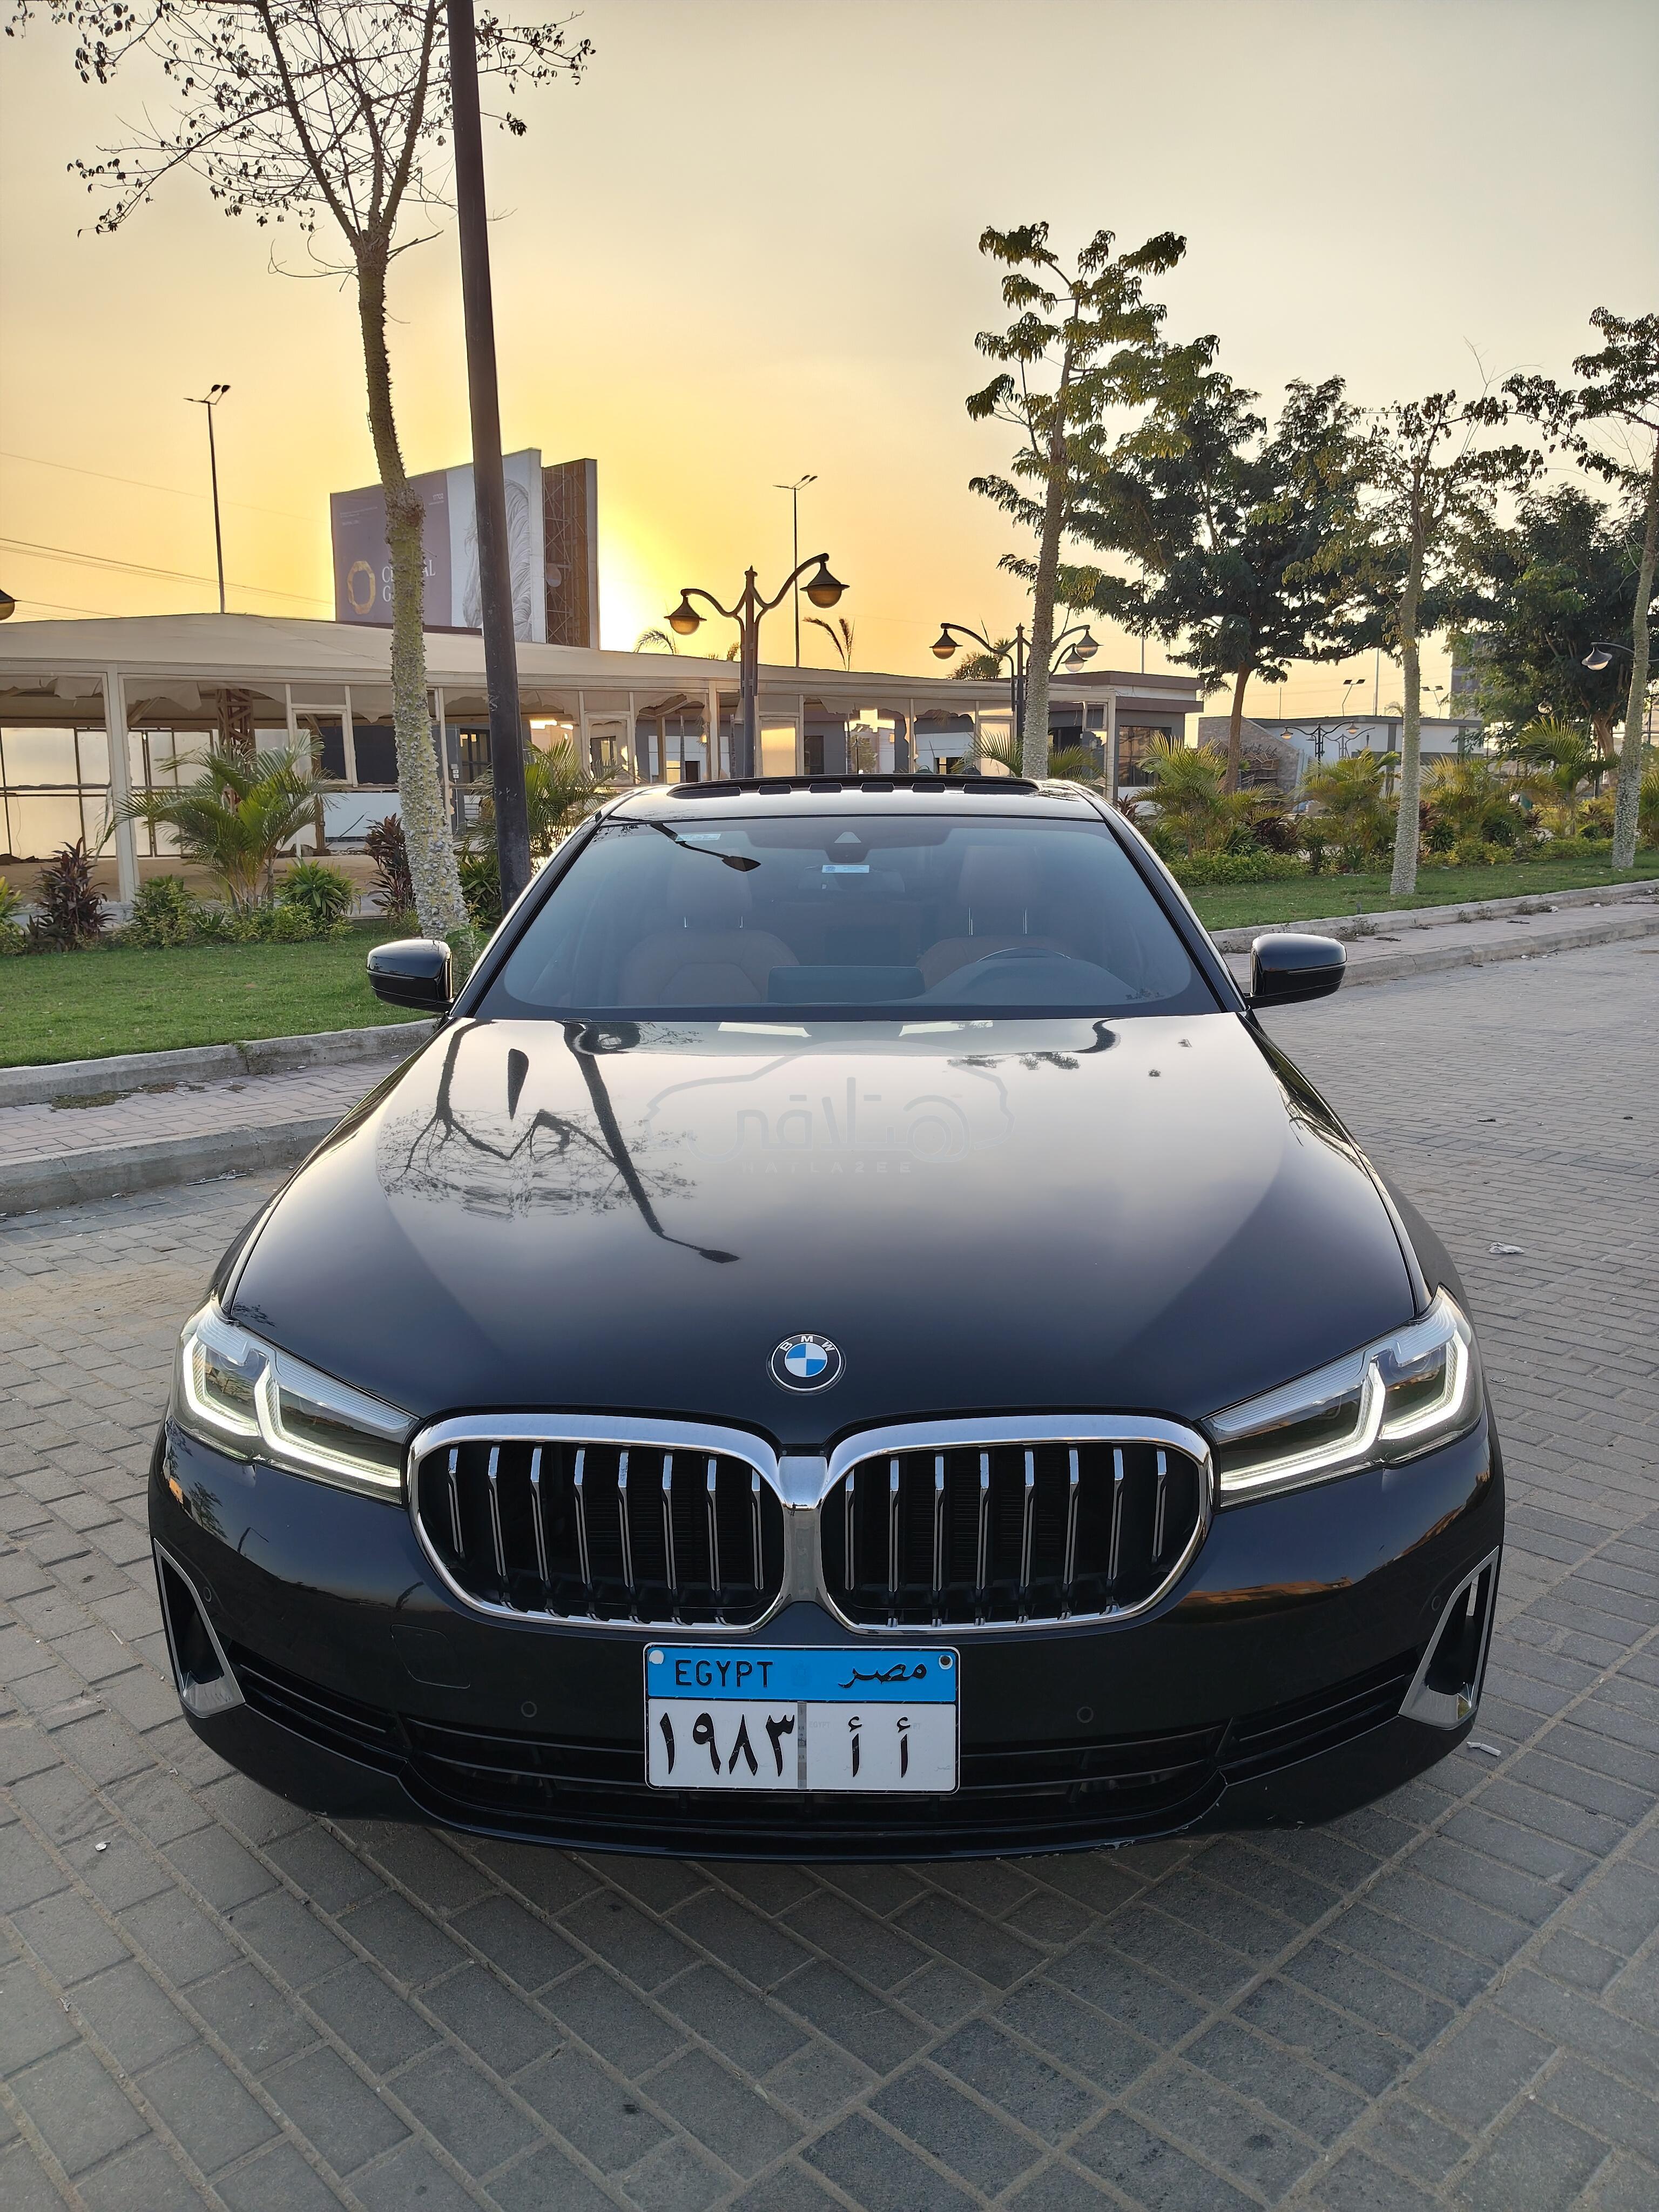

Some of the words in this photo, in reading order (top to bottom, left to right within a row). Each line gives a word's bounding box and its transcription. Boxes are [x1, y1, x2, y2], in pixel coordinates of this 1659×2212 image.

[779, 1335, 835, 1352] BMW
[675, 1659, 774, 1688] EGYPT
[838, 1663, 927, 1689] مصر
[659, 1712, 795, 1777] ١٩٨٣
